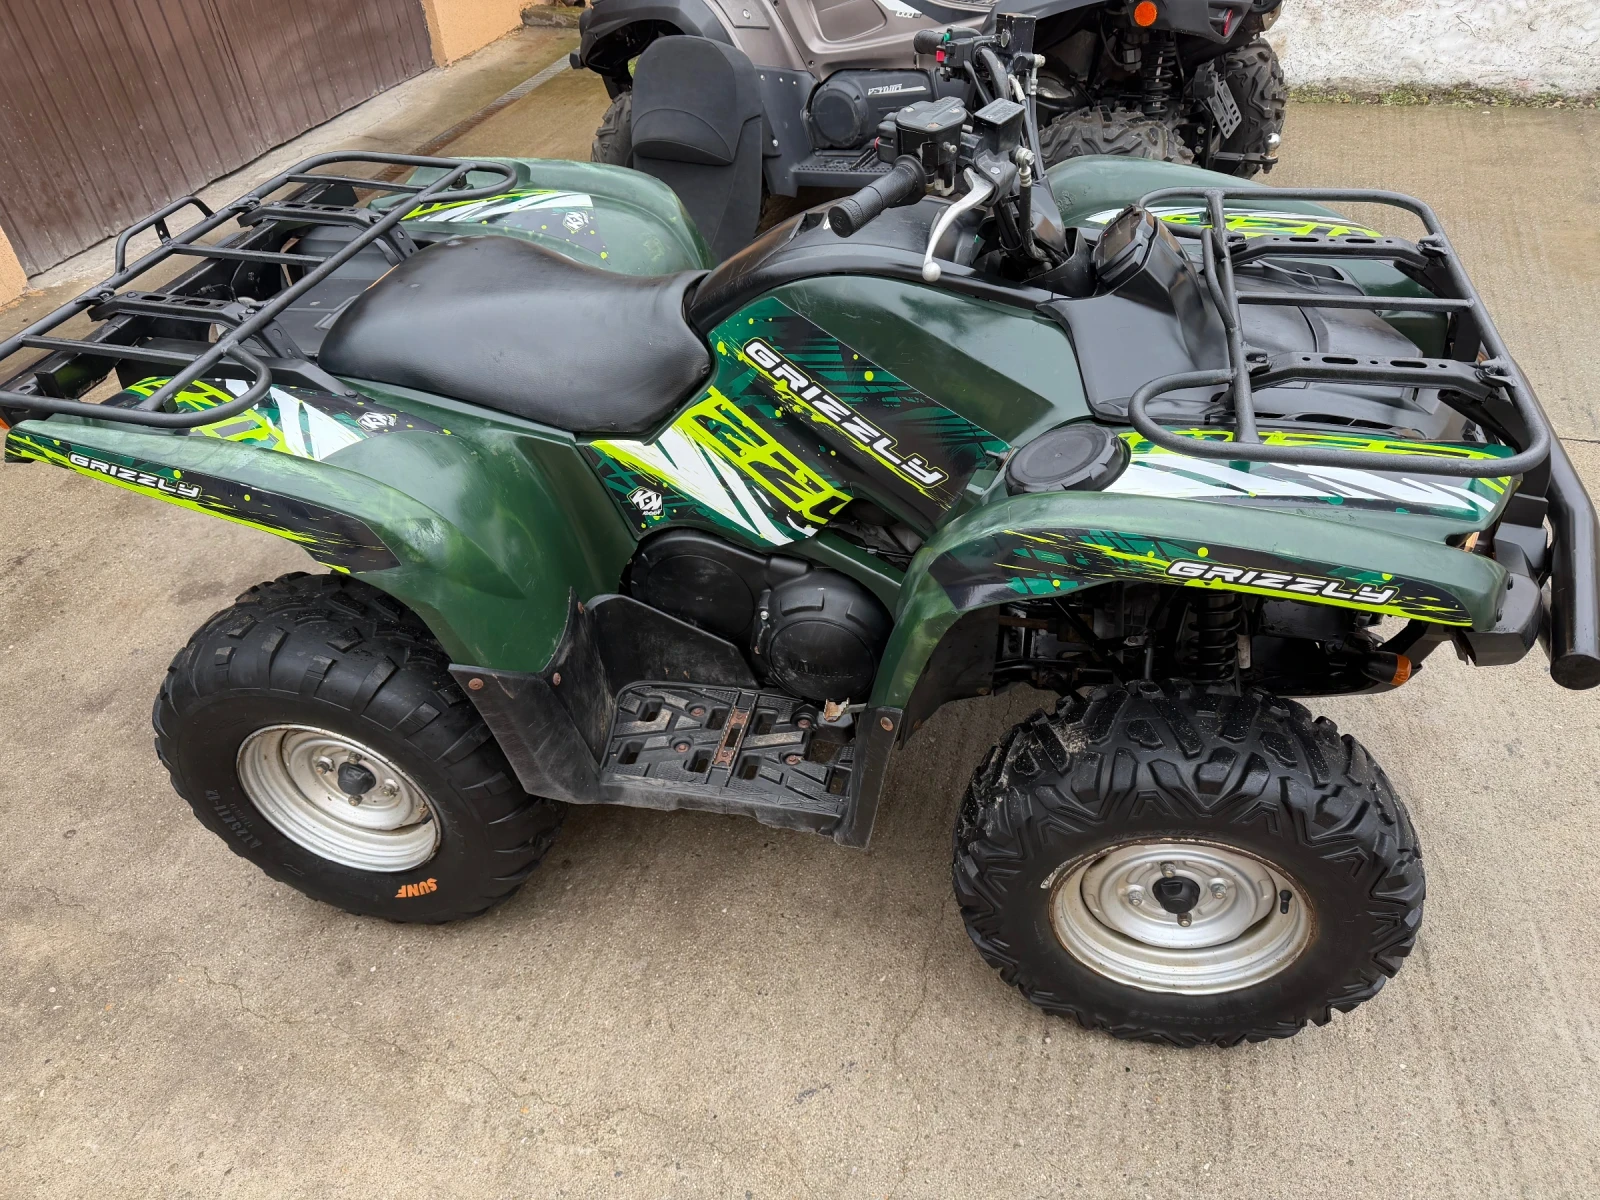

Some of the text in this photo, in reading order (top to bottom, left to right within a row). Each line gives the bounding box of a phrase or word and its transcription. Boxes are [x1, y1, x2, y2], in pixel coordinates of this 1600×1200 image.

[745, 342, 943, 484] GRIZZLY
[70, 453, 201, 498] GRIZZLY
[1168, 561, 1394, 603] GRIZZLY
[395, 878, 437, 897] SUNF
